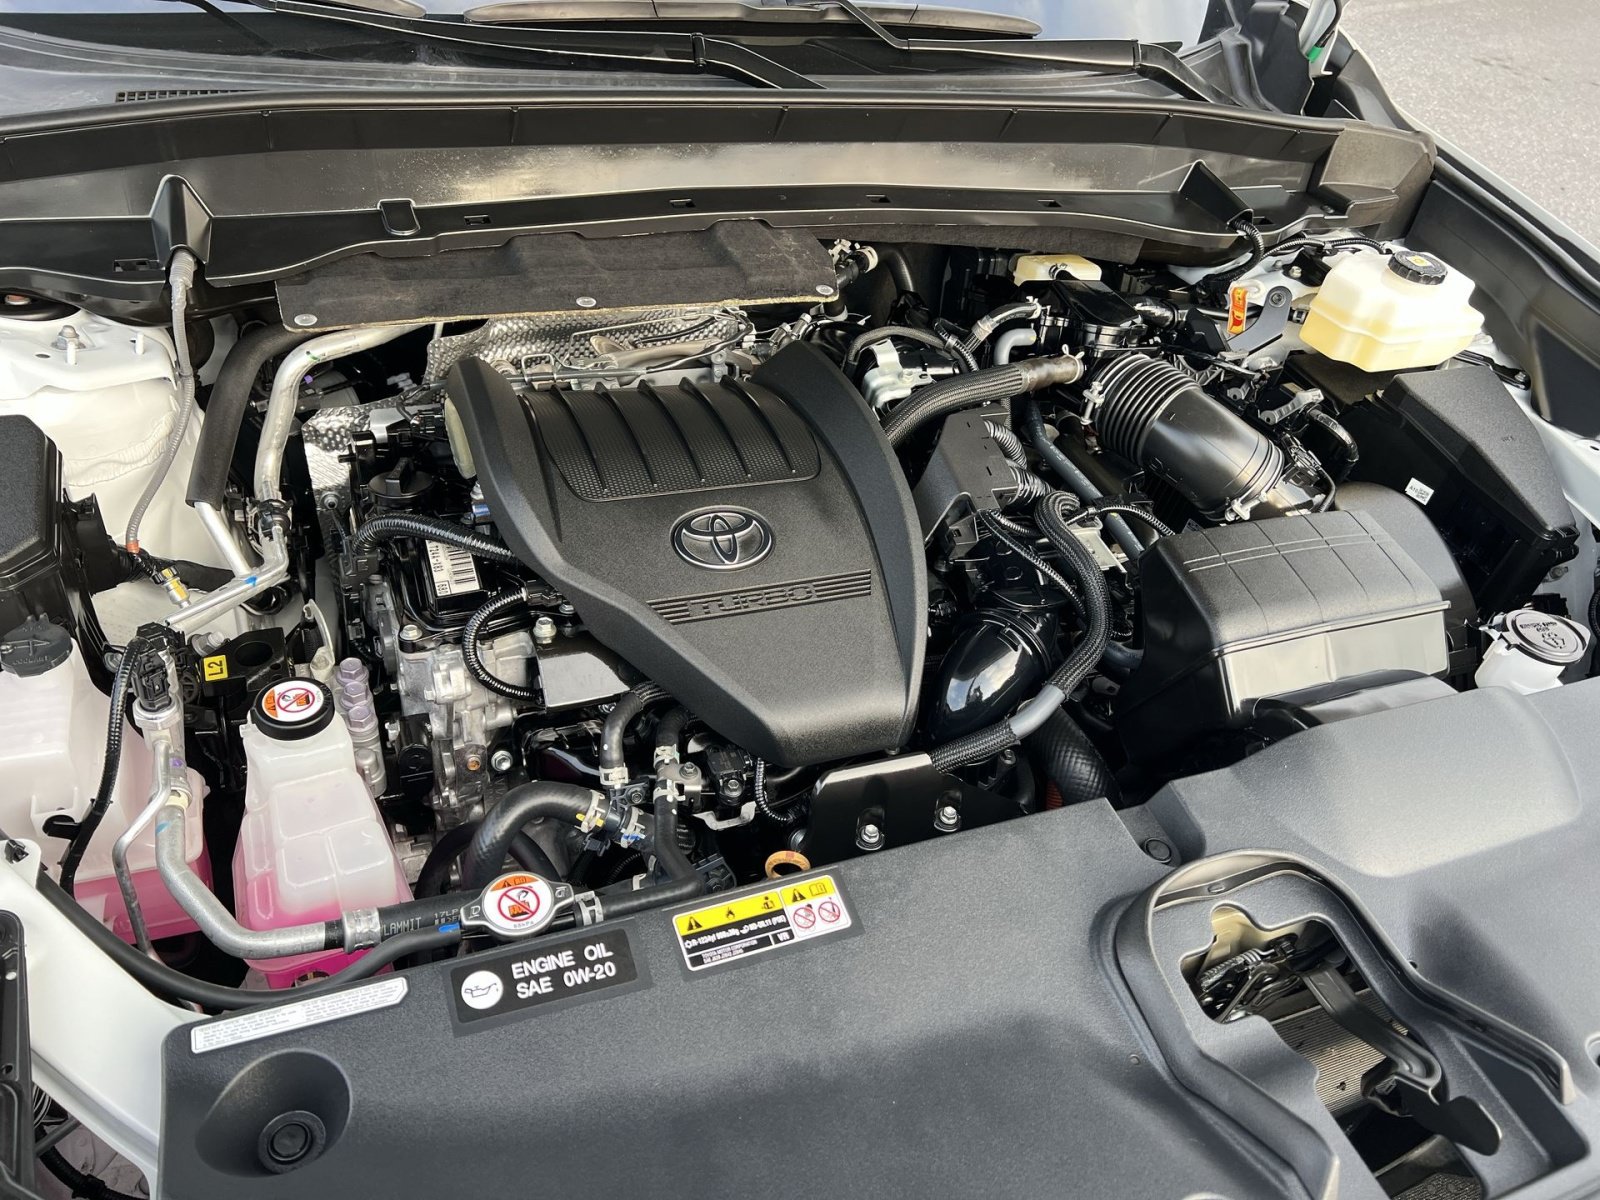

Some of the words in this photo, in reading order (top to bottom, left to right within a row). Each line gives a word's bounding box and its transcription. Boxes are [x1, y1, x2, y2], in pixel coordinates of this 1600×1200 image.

[690, 584, 815, 615] TURBO
[207, 660, 224, 677] L2
[511, 950, 576, 979] ENGINE
[583, 942, 614, 961] OIL
[516, 976, 554, 999] SAE
[563, 961, 616, 988] 0W-20
